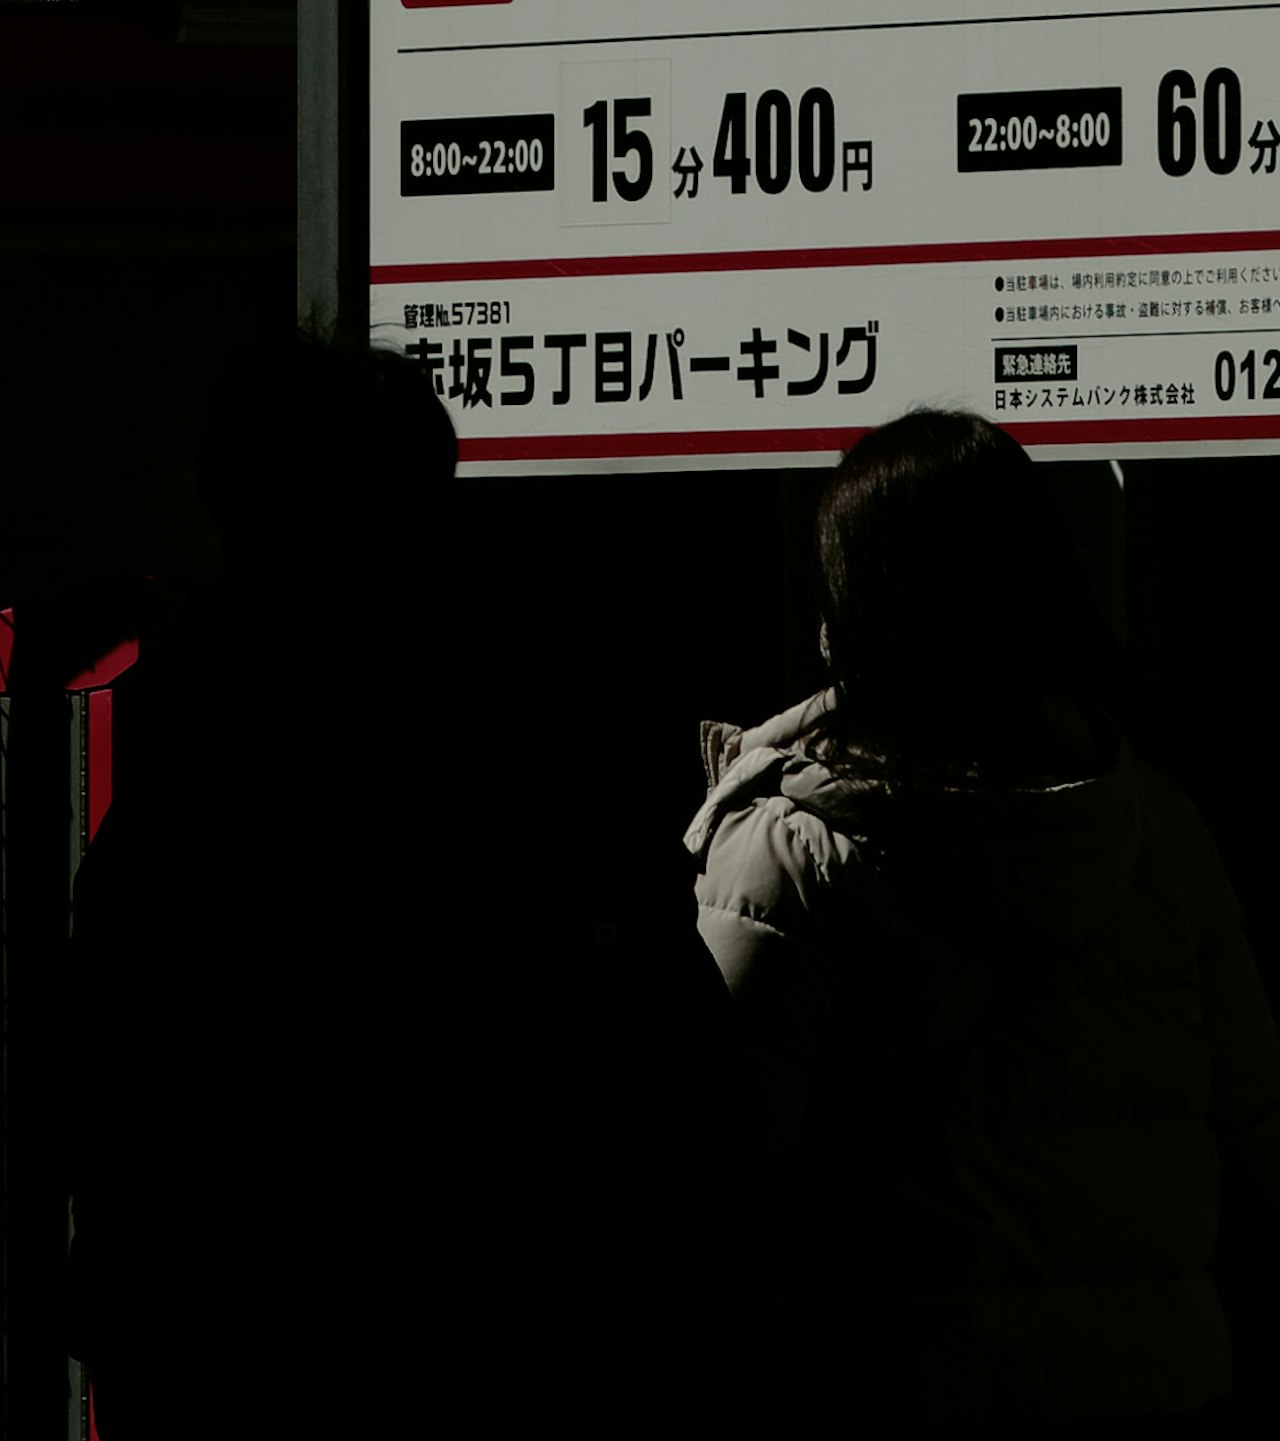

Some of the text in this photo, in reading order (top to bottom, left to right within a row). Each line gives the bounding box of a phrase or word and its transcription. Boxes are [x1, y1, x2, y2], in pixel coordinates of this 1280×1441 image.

[967, 111, 1112, 153] 22:00~8:00
[410, 137, 544, 178] 8:00~22:00
[1001, 352, 1072, 378] 緊急連絡先
[994, 382, 1196, 411] 日本システムバンク株式会社
